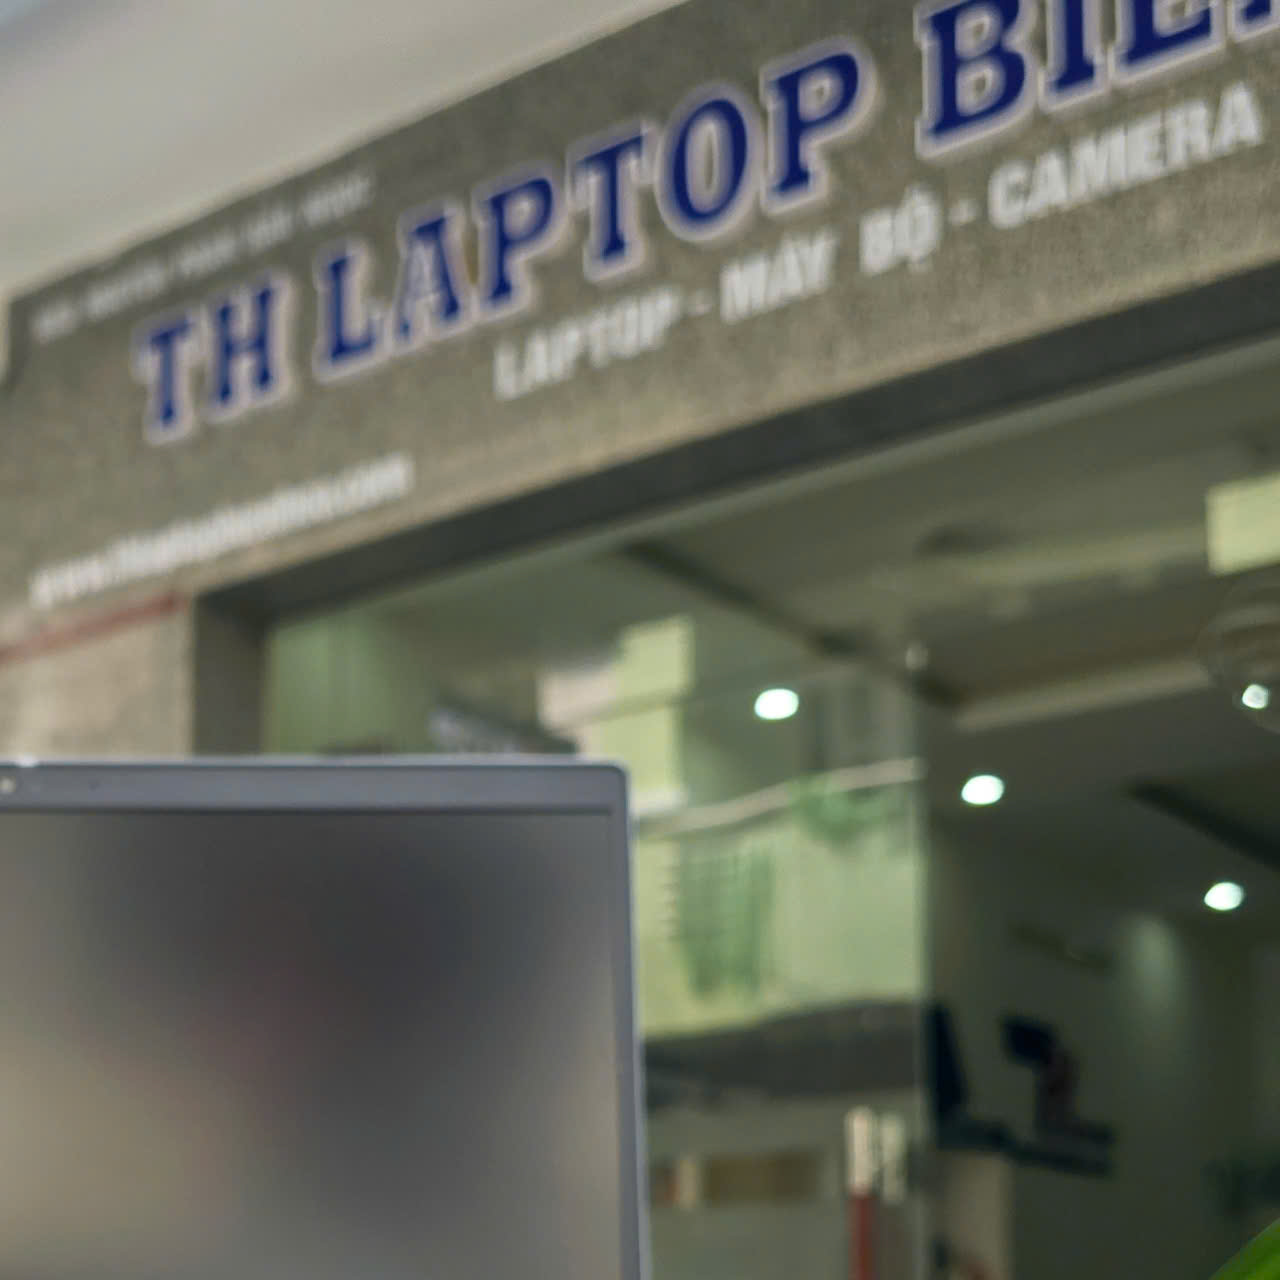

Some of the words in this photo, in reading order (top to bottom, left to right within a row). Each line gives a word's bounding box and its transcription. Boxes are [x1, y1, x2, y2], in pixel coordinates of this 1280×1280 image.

[133, 274, 293, 444] TH
[314, 37, 877, 382] LAPTOP
[988, 82, 1262, 229] CAMERA
